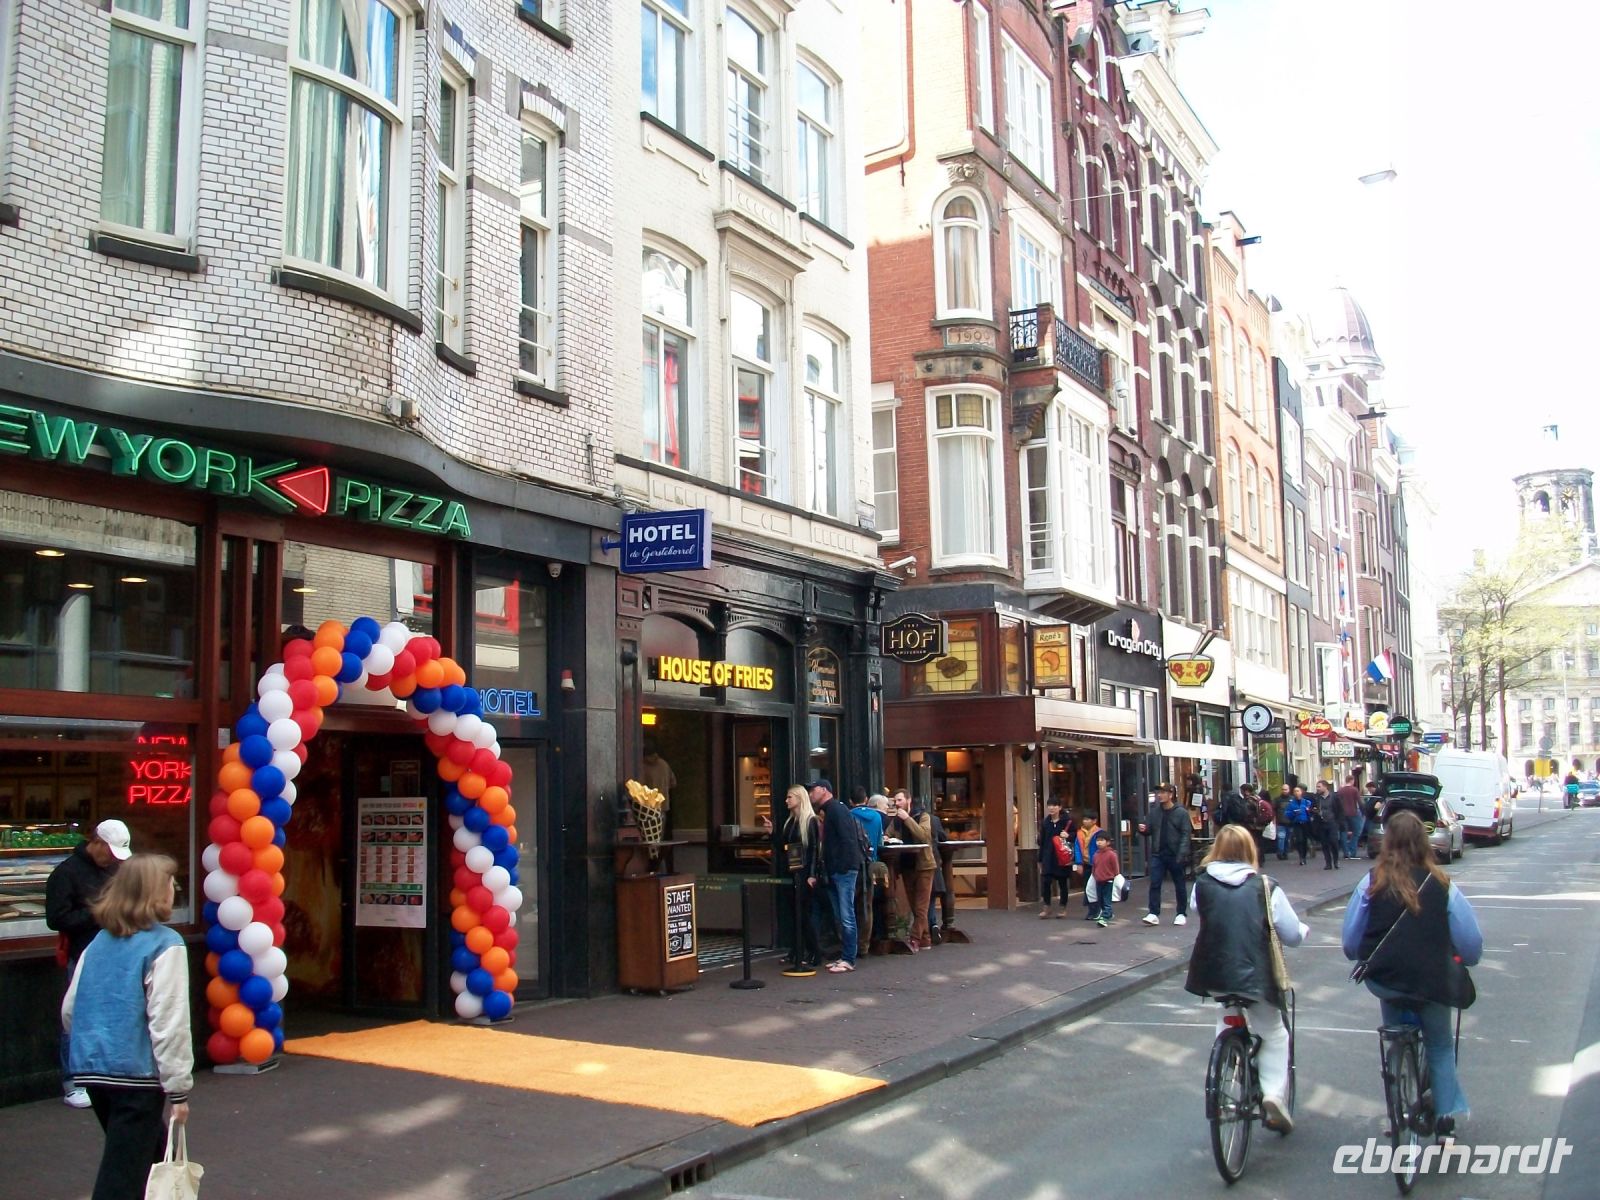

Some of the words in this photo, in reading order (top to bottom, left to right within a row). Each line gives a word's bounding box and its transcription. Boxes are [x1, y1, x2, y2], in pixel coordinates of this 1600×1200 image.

[102, 426, 298, 513] YORK
[335, 475, 471, 539] PIZZA
[629, 524, 697, 544] HOTEL
[629, 550, 640, 558] de
[889, 628, 936, 650] HOF
[1108, 630, 1143, 654] Dragon
[1144, 639, 1162, 661] City
[660, 655, 712, 685] HOUSE
[713, 662, 734, 687] OF
[735, 665, 773, 691] FRIES
[130, 760, 193, 779] YORK
[667, 890, 690, 904] STAFF
[668, 903, 691, 914] WANTED
